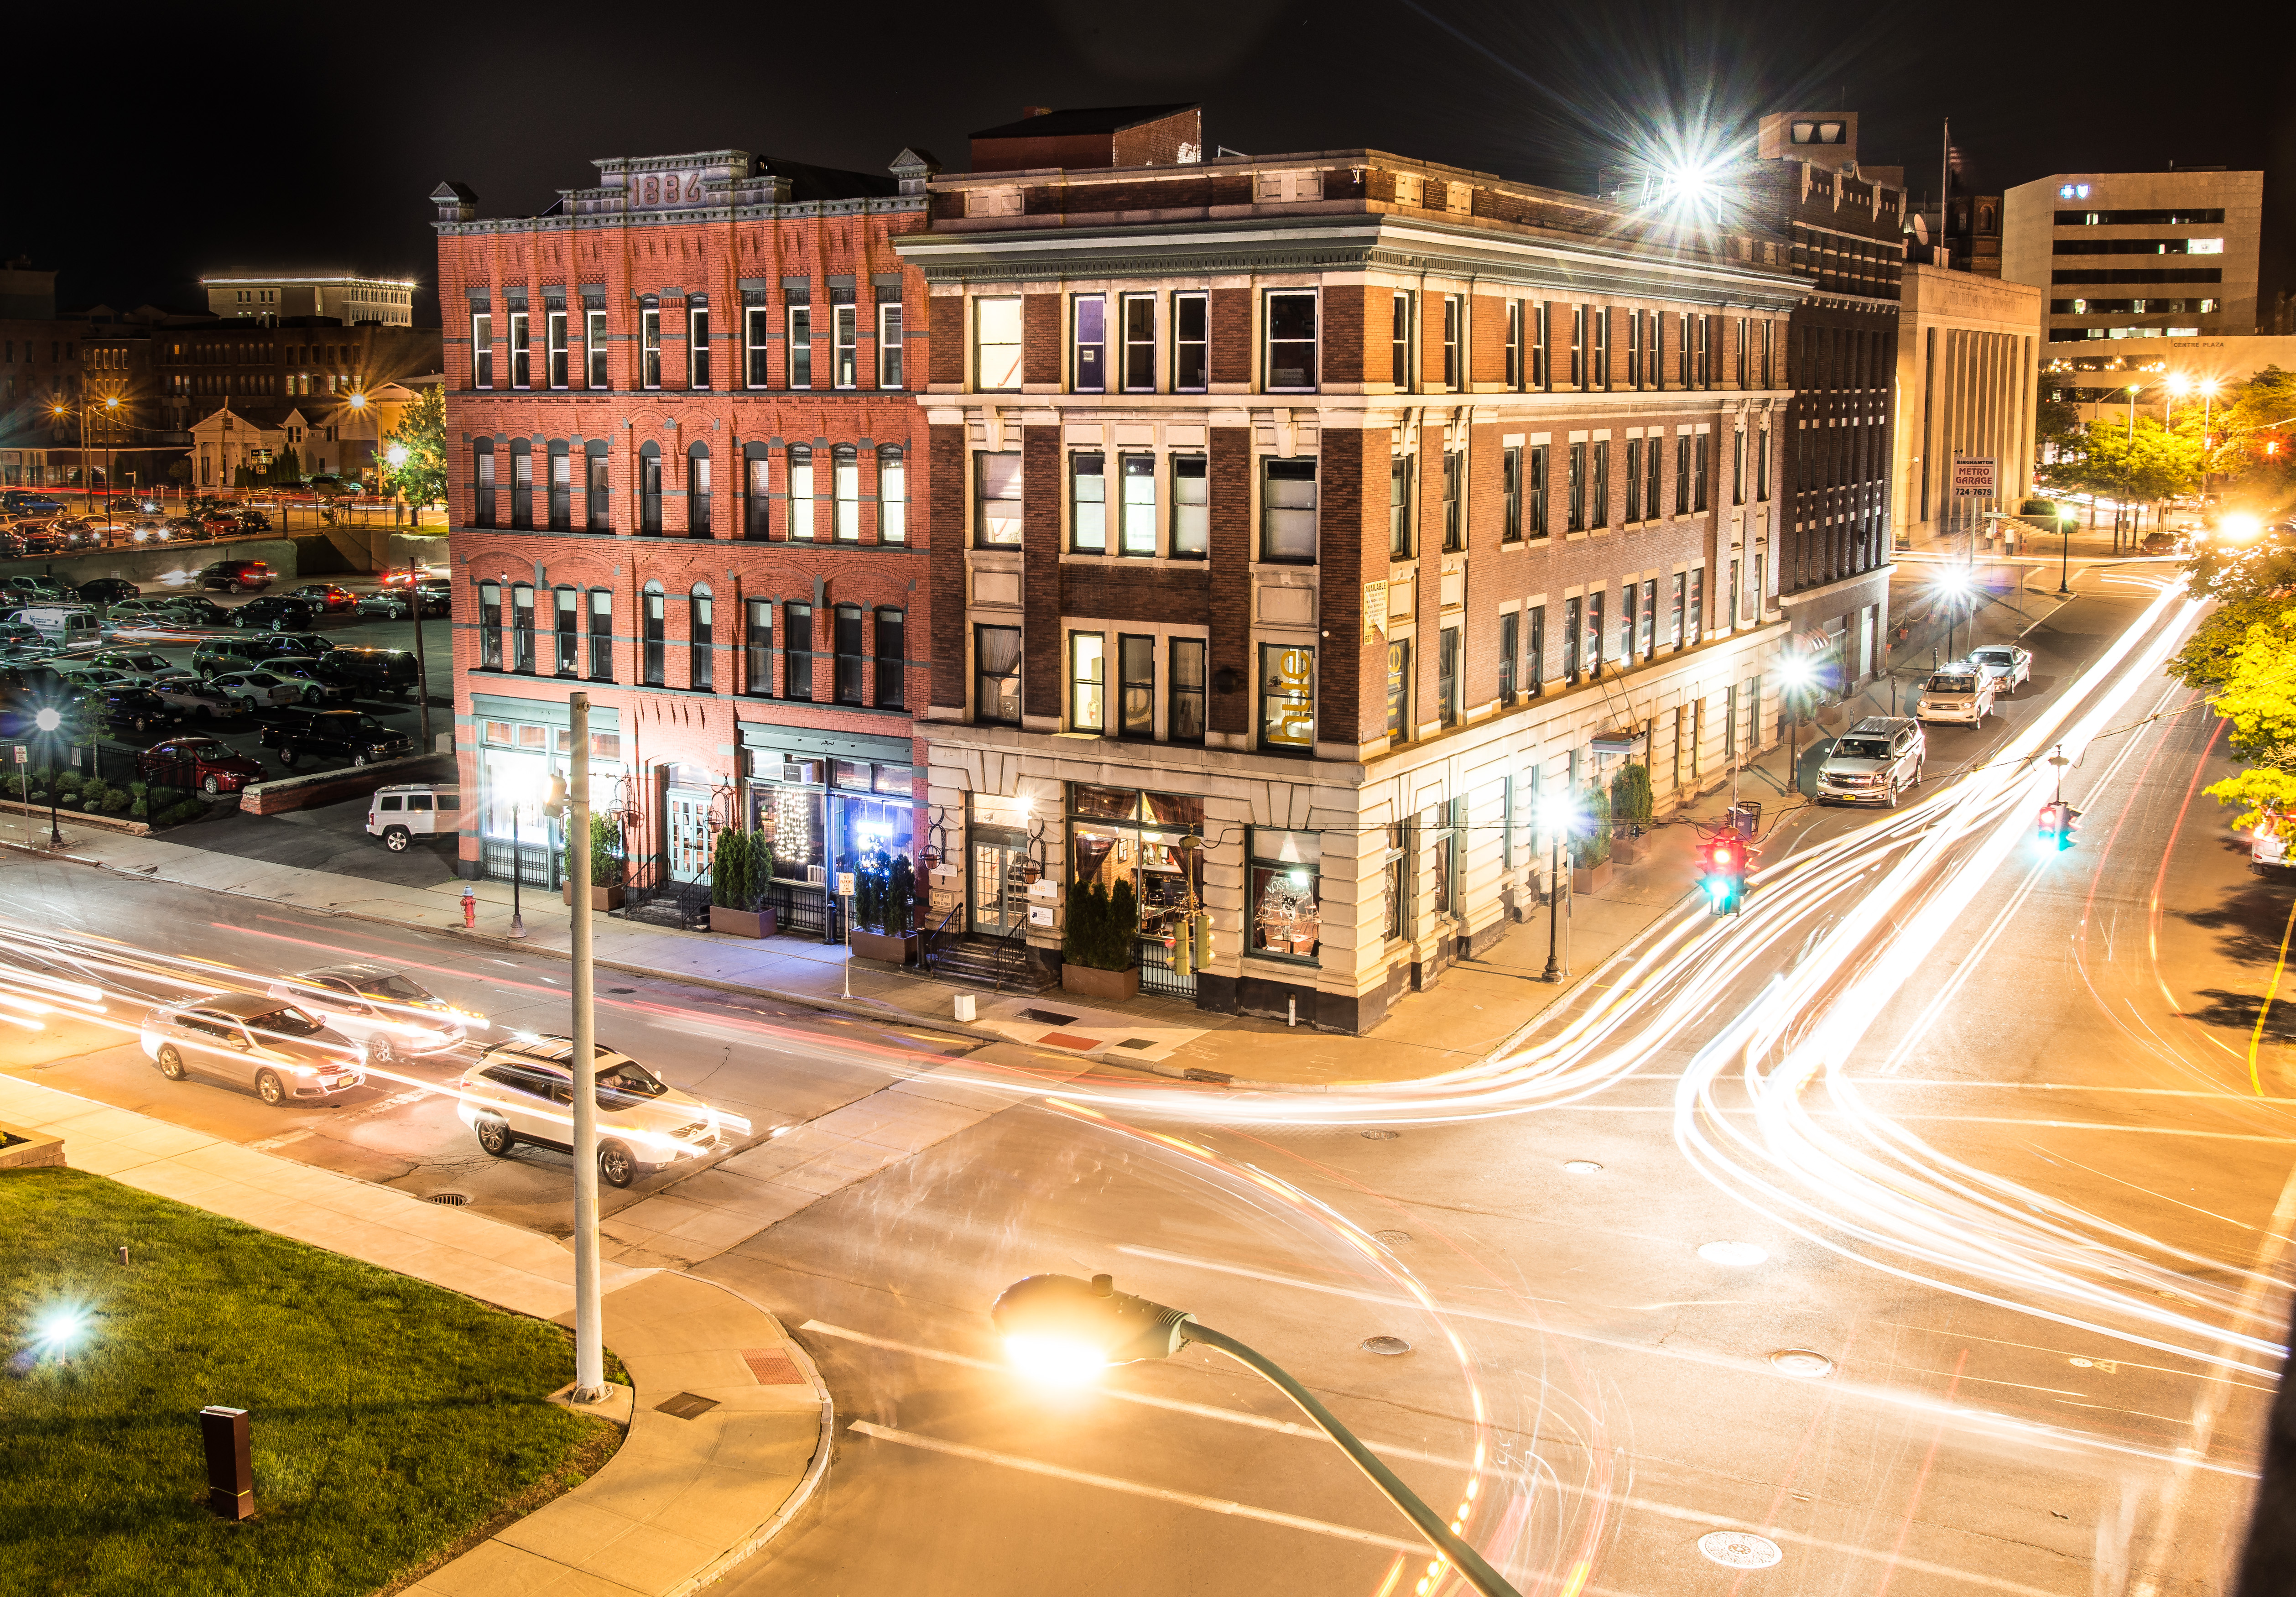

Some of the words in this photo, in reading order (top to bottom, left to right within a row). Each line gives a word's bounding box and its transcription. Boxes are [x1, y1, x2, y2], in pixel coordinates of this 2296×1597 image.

[633, 174, 700, 206] 1886
[1959, 468, 1989, 476] METRO
[1365, 583, 1386, 593] AVAILABLE
[1270, 651, 1310, 744] hue
